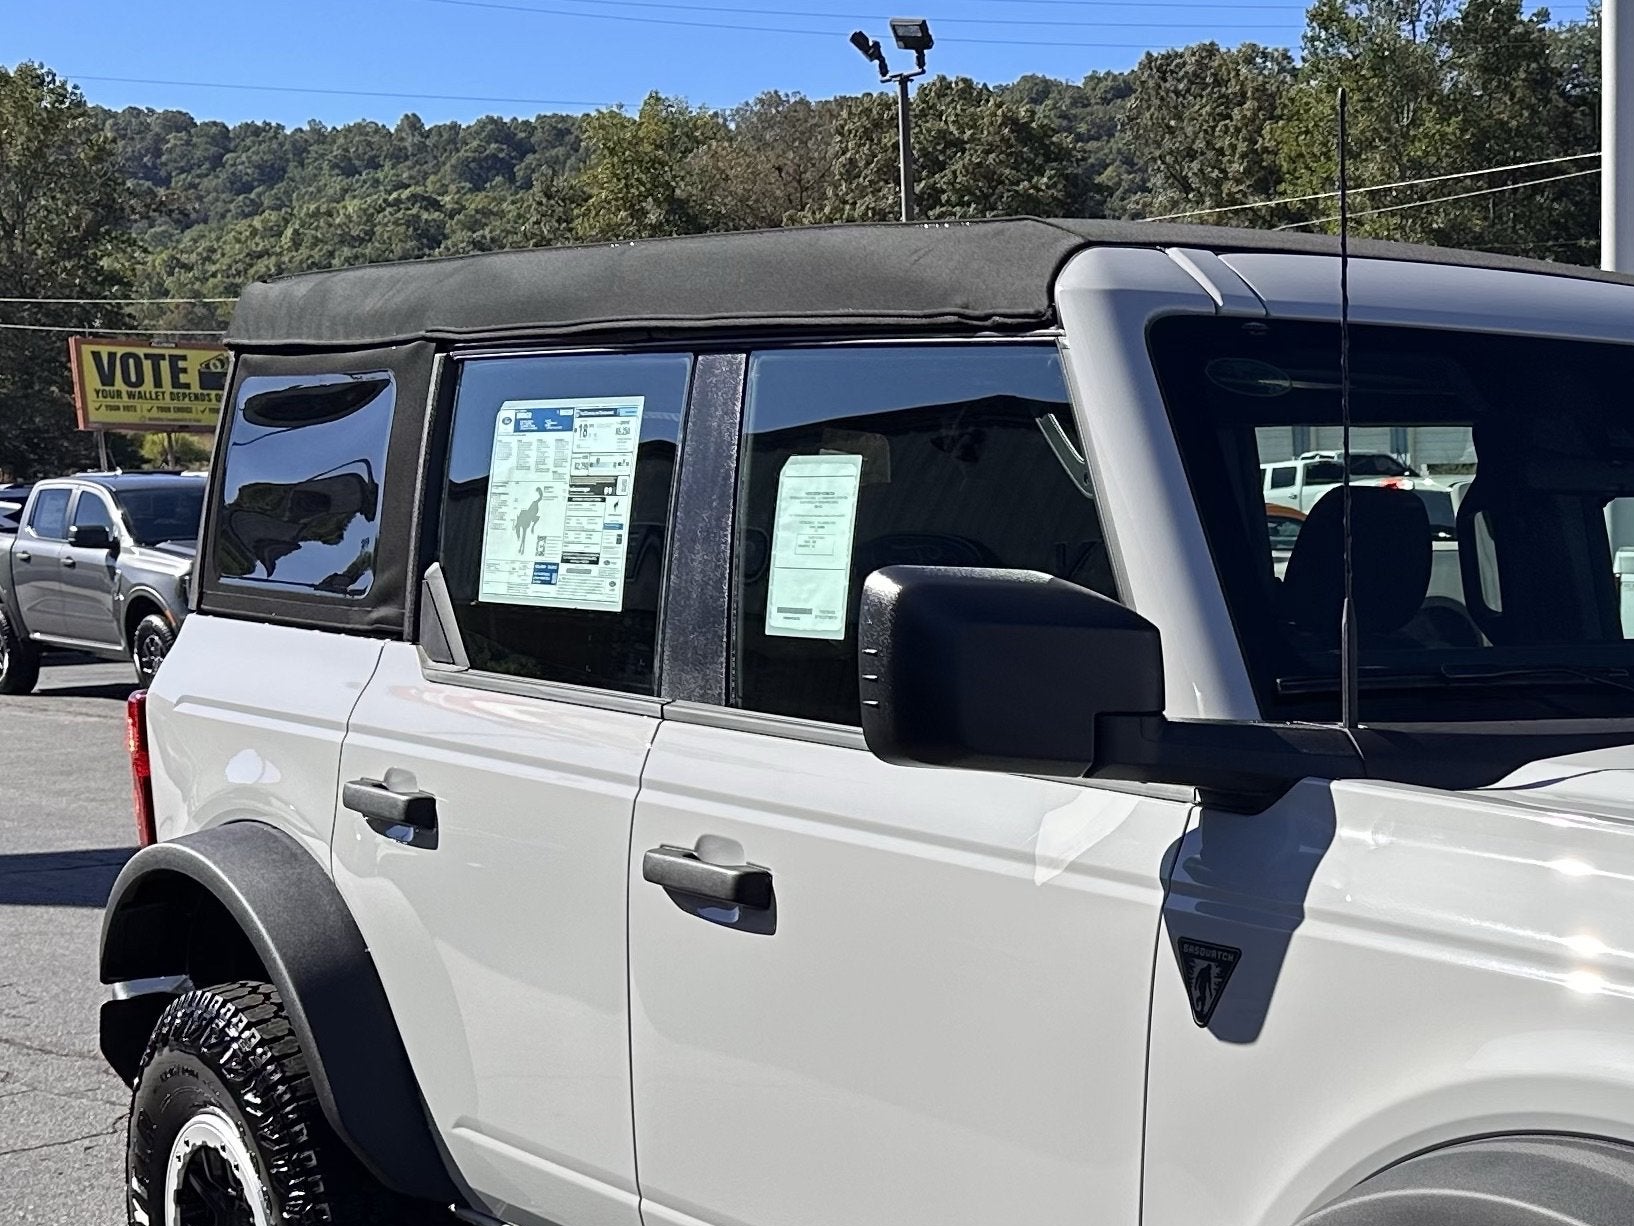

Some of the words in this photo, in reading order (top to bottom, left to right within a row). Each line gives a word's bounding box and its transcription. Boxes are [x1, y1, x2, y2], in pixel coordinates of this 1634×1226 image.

[91, 351, 191, 390] VOTE
[94, 388, 123, 399] YOUR
[126, 390, 166, 401] WALLET
[169, 391, 212, 402] DEPENDS
[1182, 943, 1235, 962] SASQUATCH
